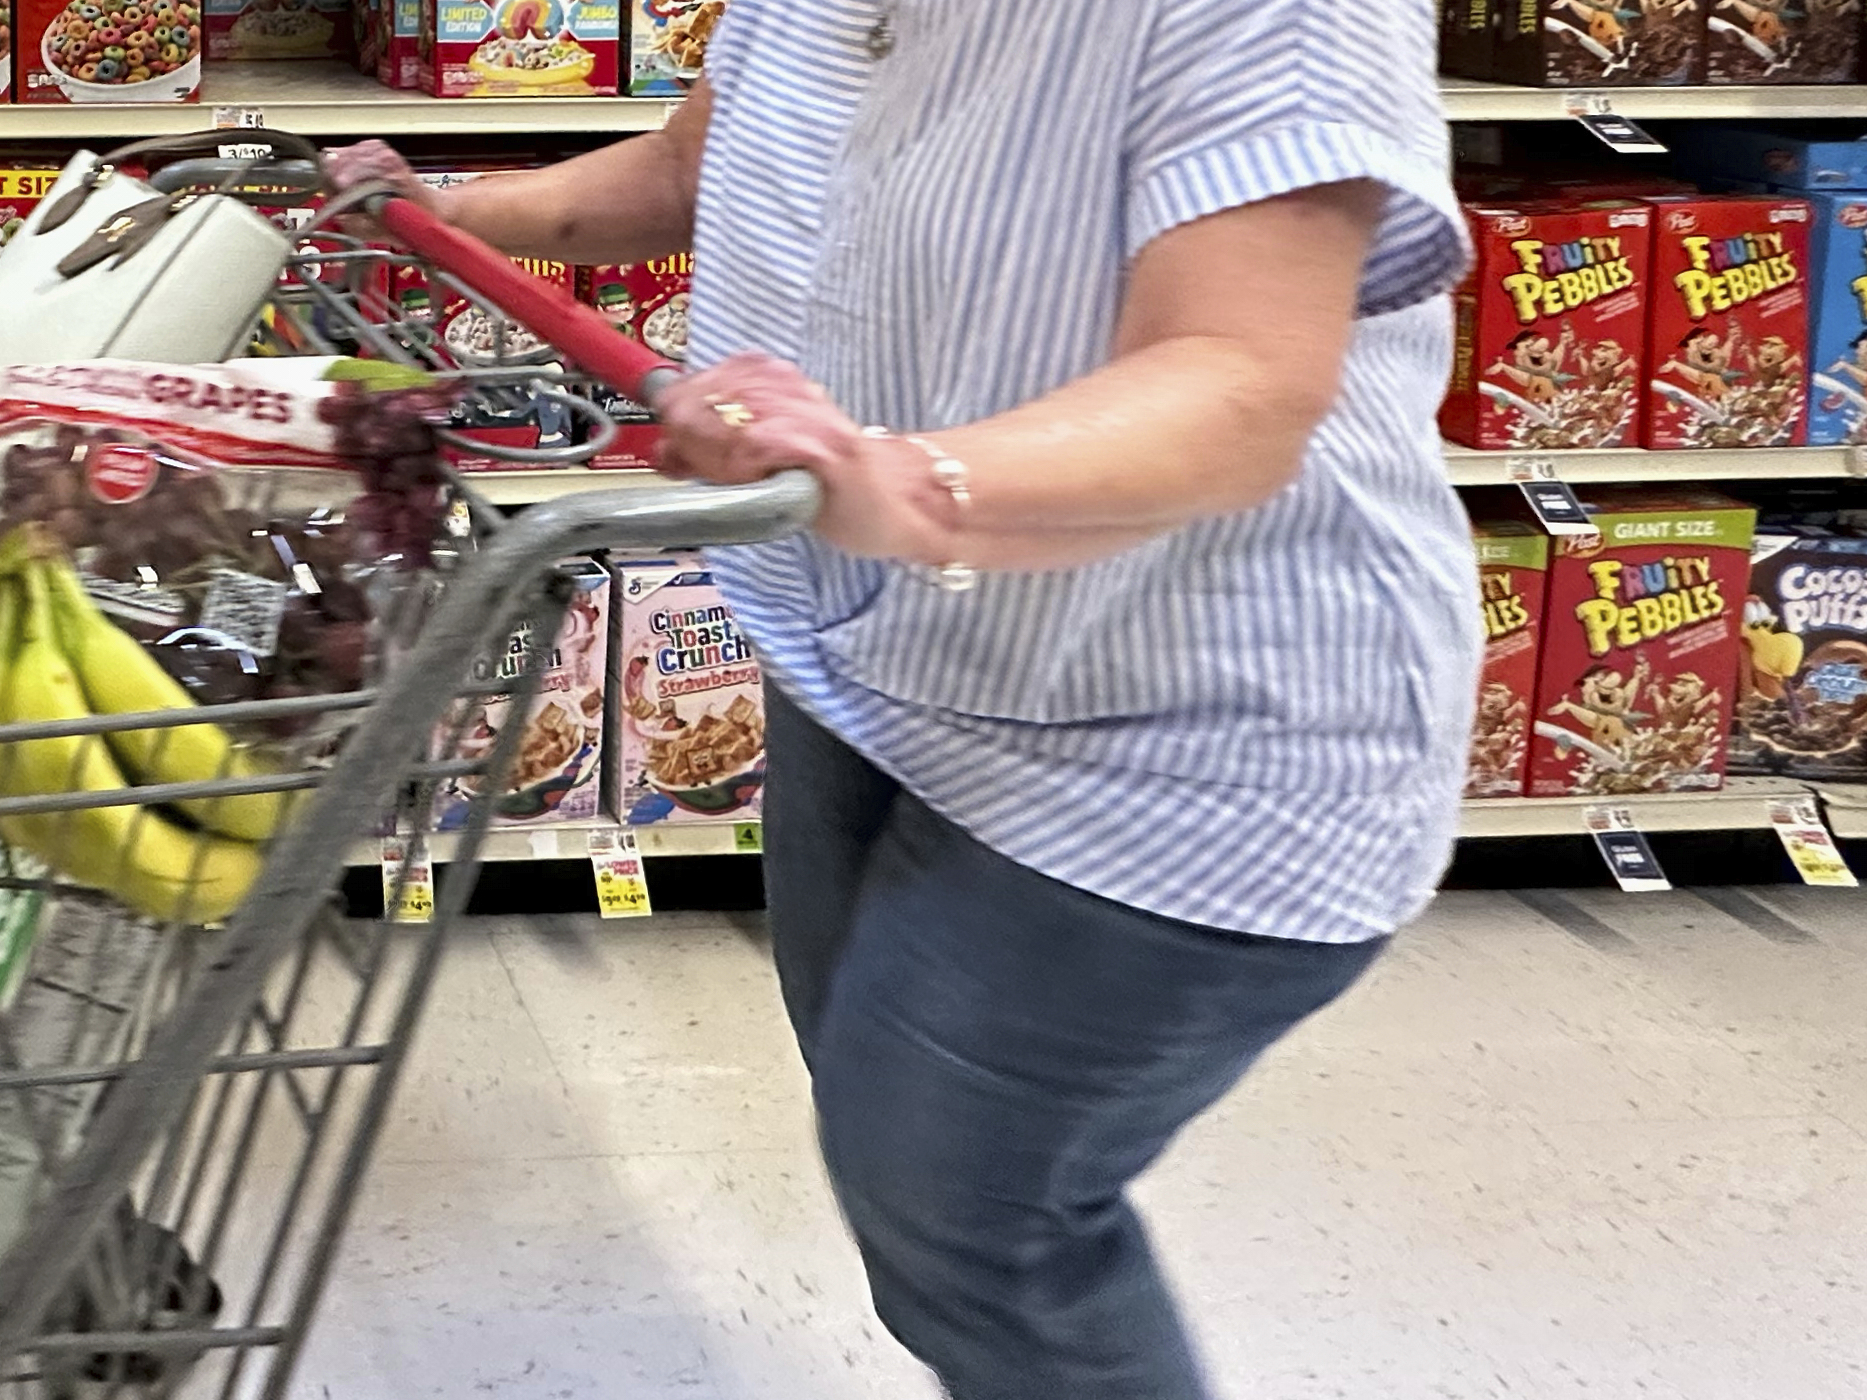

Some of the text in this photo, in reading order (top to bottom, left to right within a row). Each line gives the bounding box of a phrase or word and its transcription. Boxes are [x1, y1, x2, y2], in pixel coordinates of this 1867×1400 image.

[441, 7, 487, 21] LIMITED
[446, 20, 481, 32] EDITION
[576, 7, 616, 21] JUMBO
[1504, 257, 1634, 323] PEBBLES
[1675, 254, 1797, 320] PEBBLES
[1576, 582, 1725, 657] PEBBLES
[658, 667, 759, 696] Strawberry
